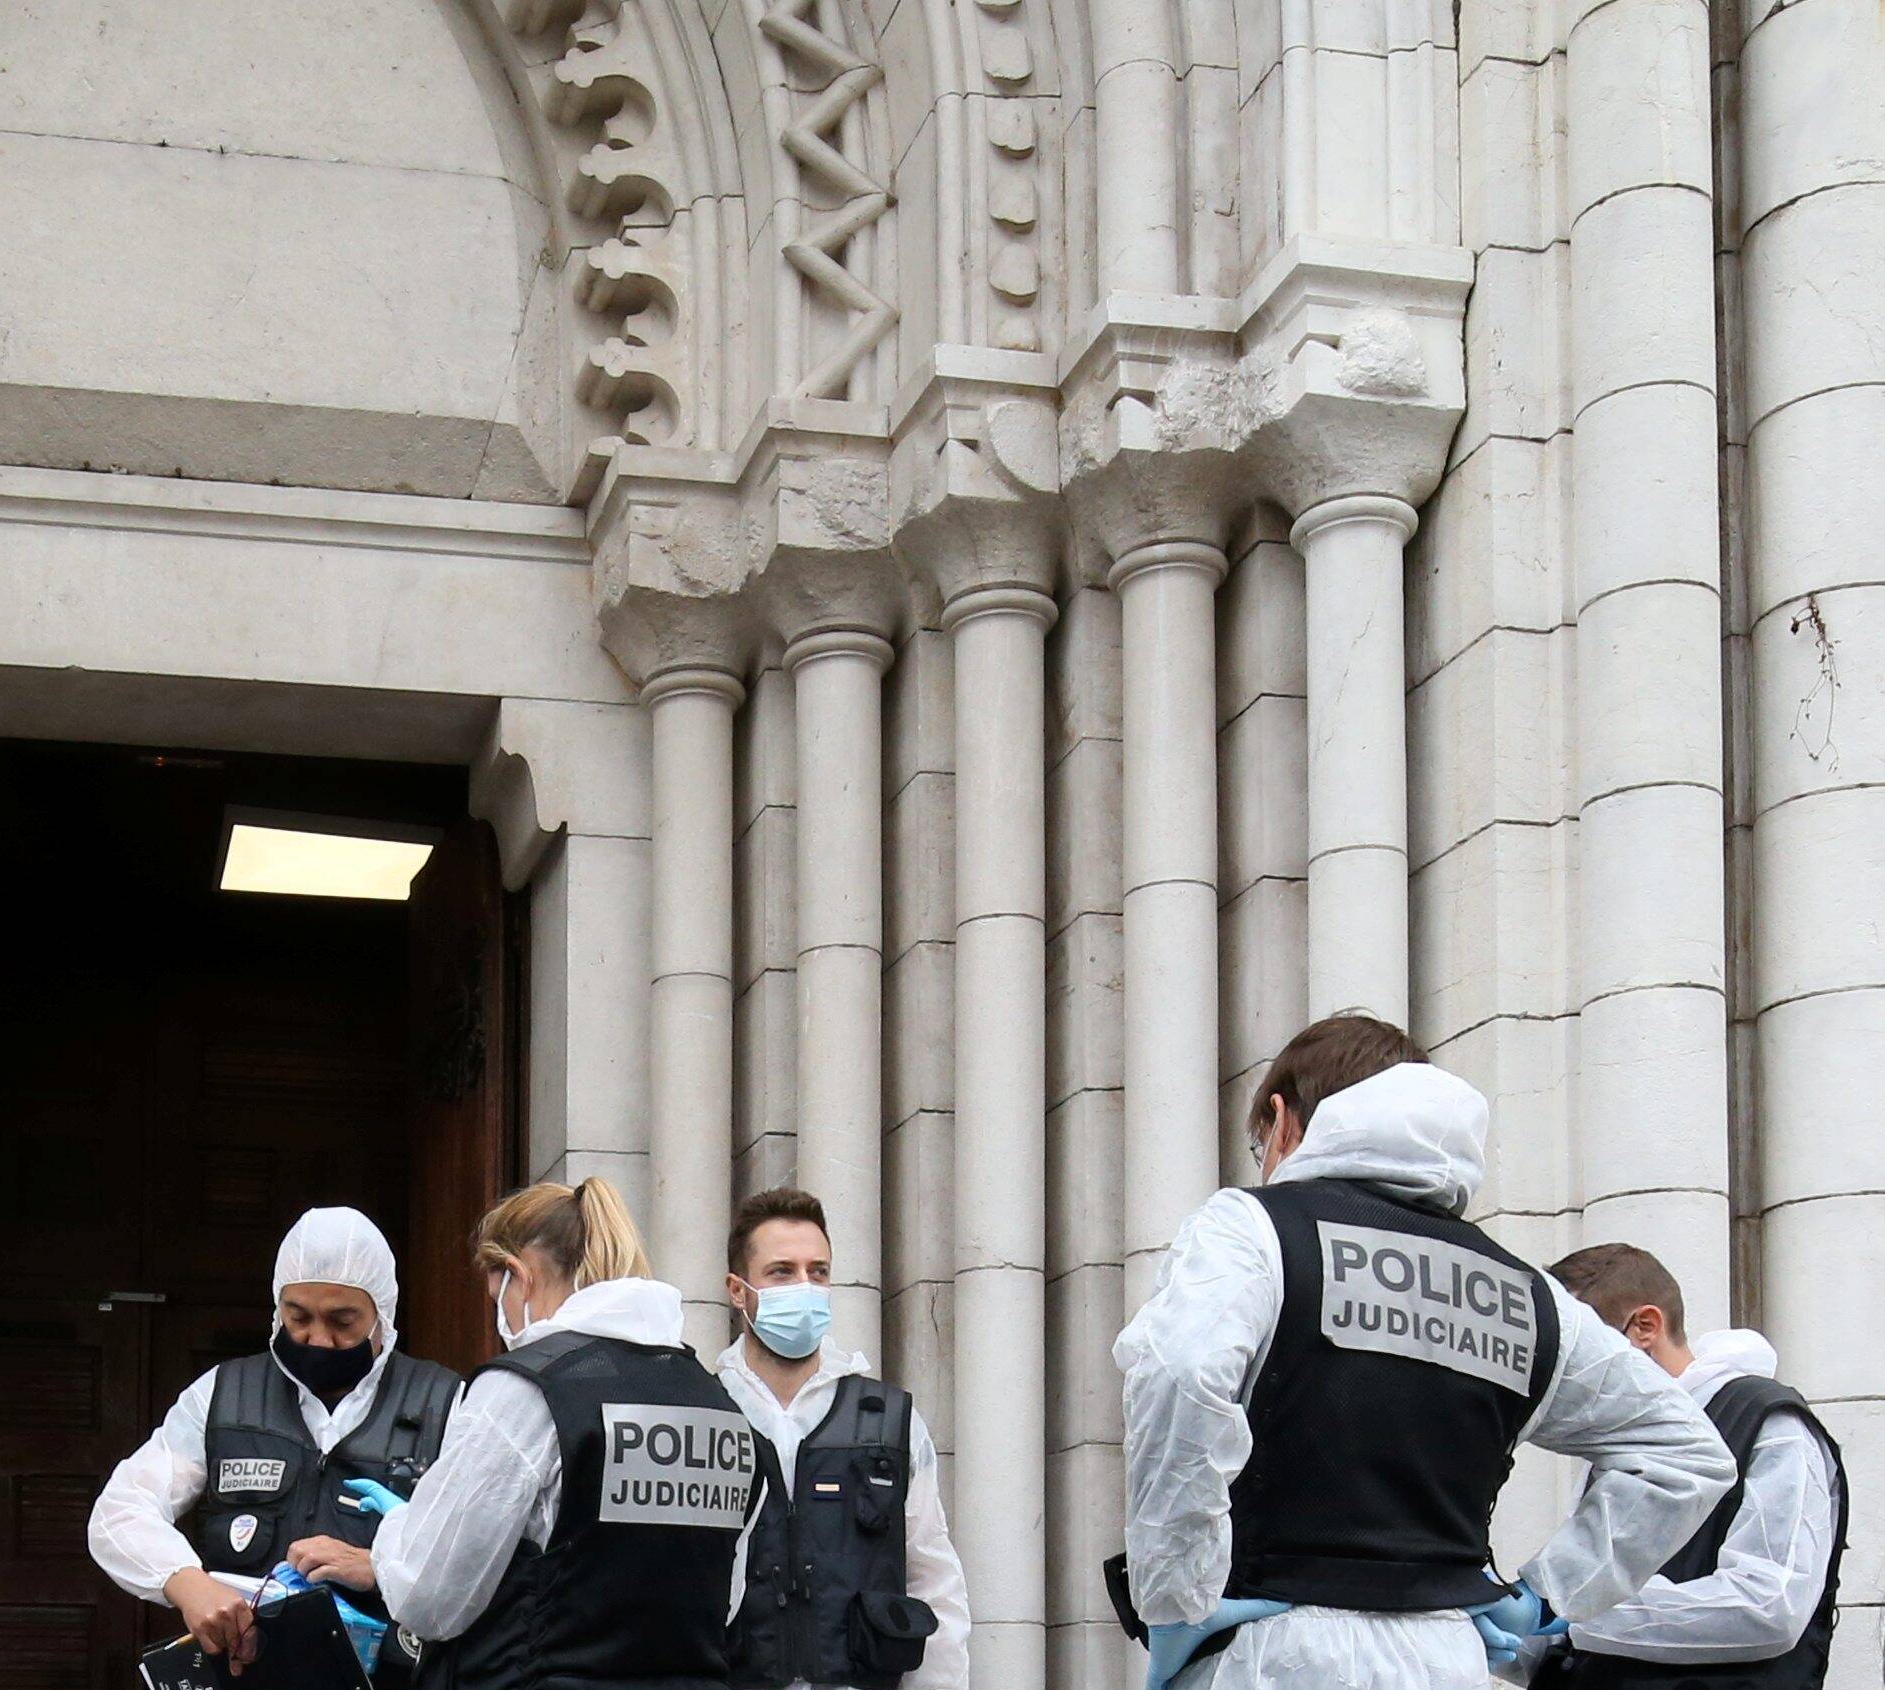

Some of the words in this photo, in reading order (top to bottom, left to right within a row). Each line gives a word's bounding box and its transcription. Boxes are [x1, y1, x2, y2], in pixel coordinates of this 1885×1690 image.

[1330, 1238, 1530, 1331] POLICE
[1331, 1300, 1528, 1375] JUDICIAIRE
[613, 1421, 752, 1473] POLICE
[221, 1462, 282, 1477] POLICE
[221, 1478, 279, 1489] JUDICIAIRE
[610, 1479, 748, 1512] JUDICIAIRE
